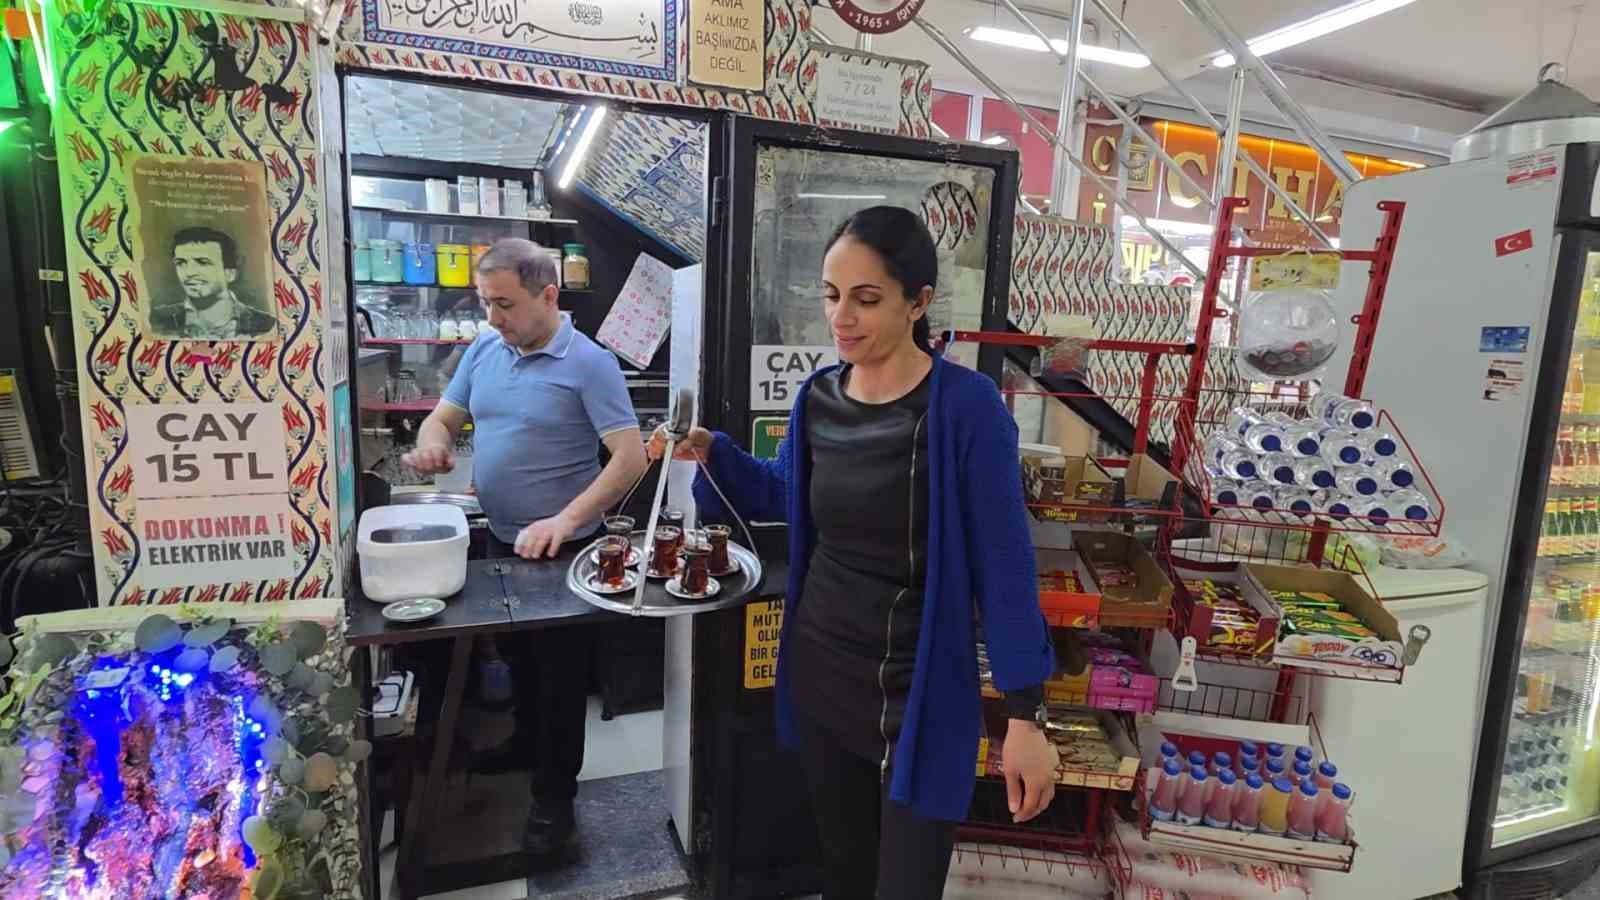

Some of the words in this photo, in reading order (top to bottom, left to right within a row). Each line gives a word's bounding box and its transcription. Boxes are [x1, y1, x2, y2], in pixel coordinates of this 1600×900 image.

[711, 0, 745, 10] AMA
[704, 12, 750, 31] AKLIMIZ
[856, 13, 882, 28] 1965
[710, 55, 745, 73] DEĞİL
[766, 351, 824, 379] ÇAY
[759, 380, 788, 401] 15
[156, 412, 258, 450] ÇAY
[145, 454, 200, 483] 15
[213, 452, 274, 481] TL
[144, 515, 270, 541] DOKUNMA
[148, 540, 243, 566] ELEKTRİK
[246, 540, 286, 559] VAR
[753, 614, 780, 628] MUT
